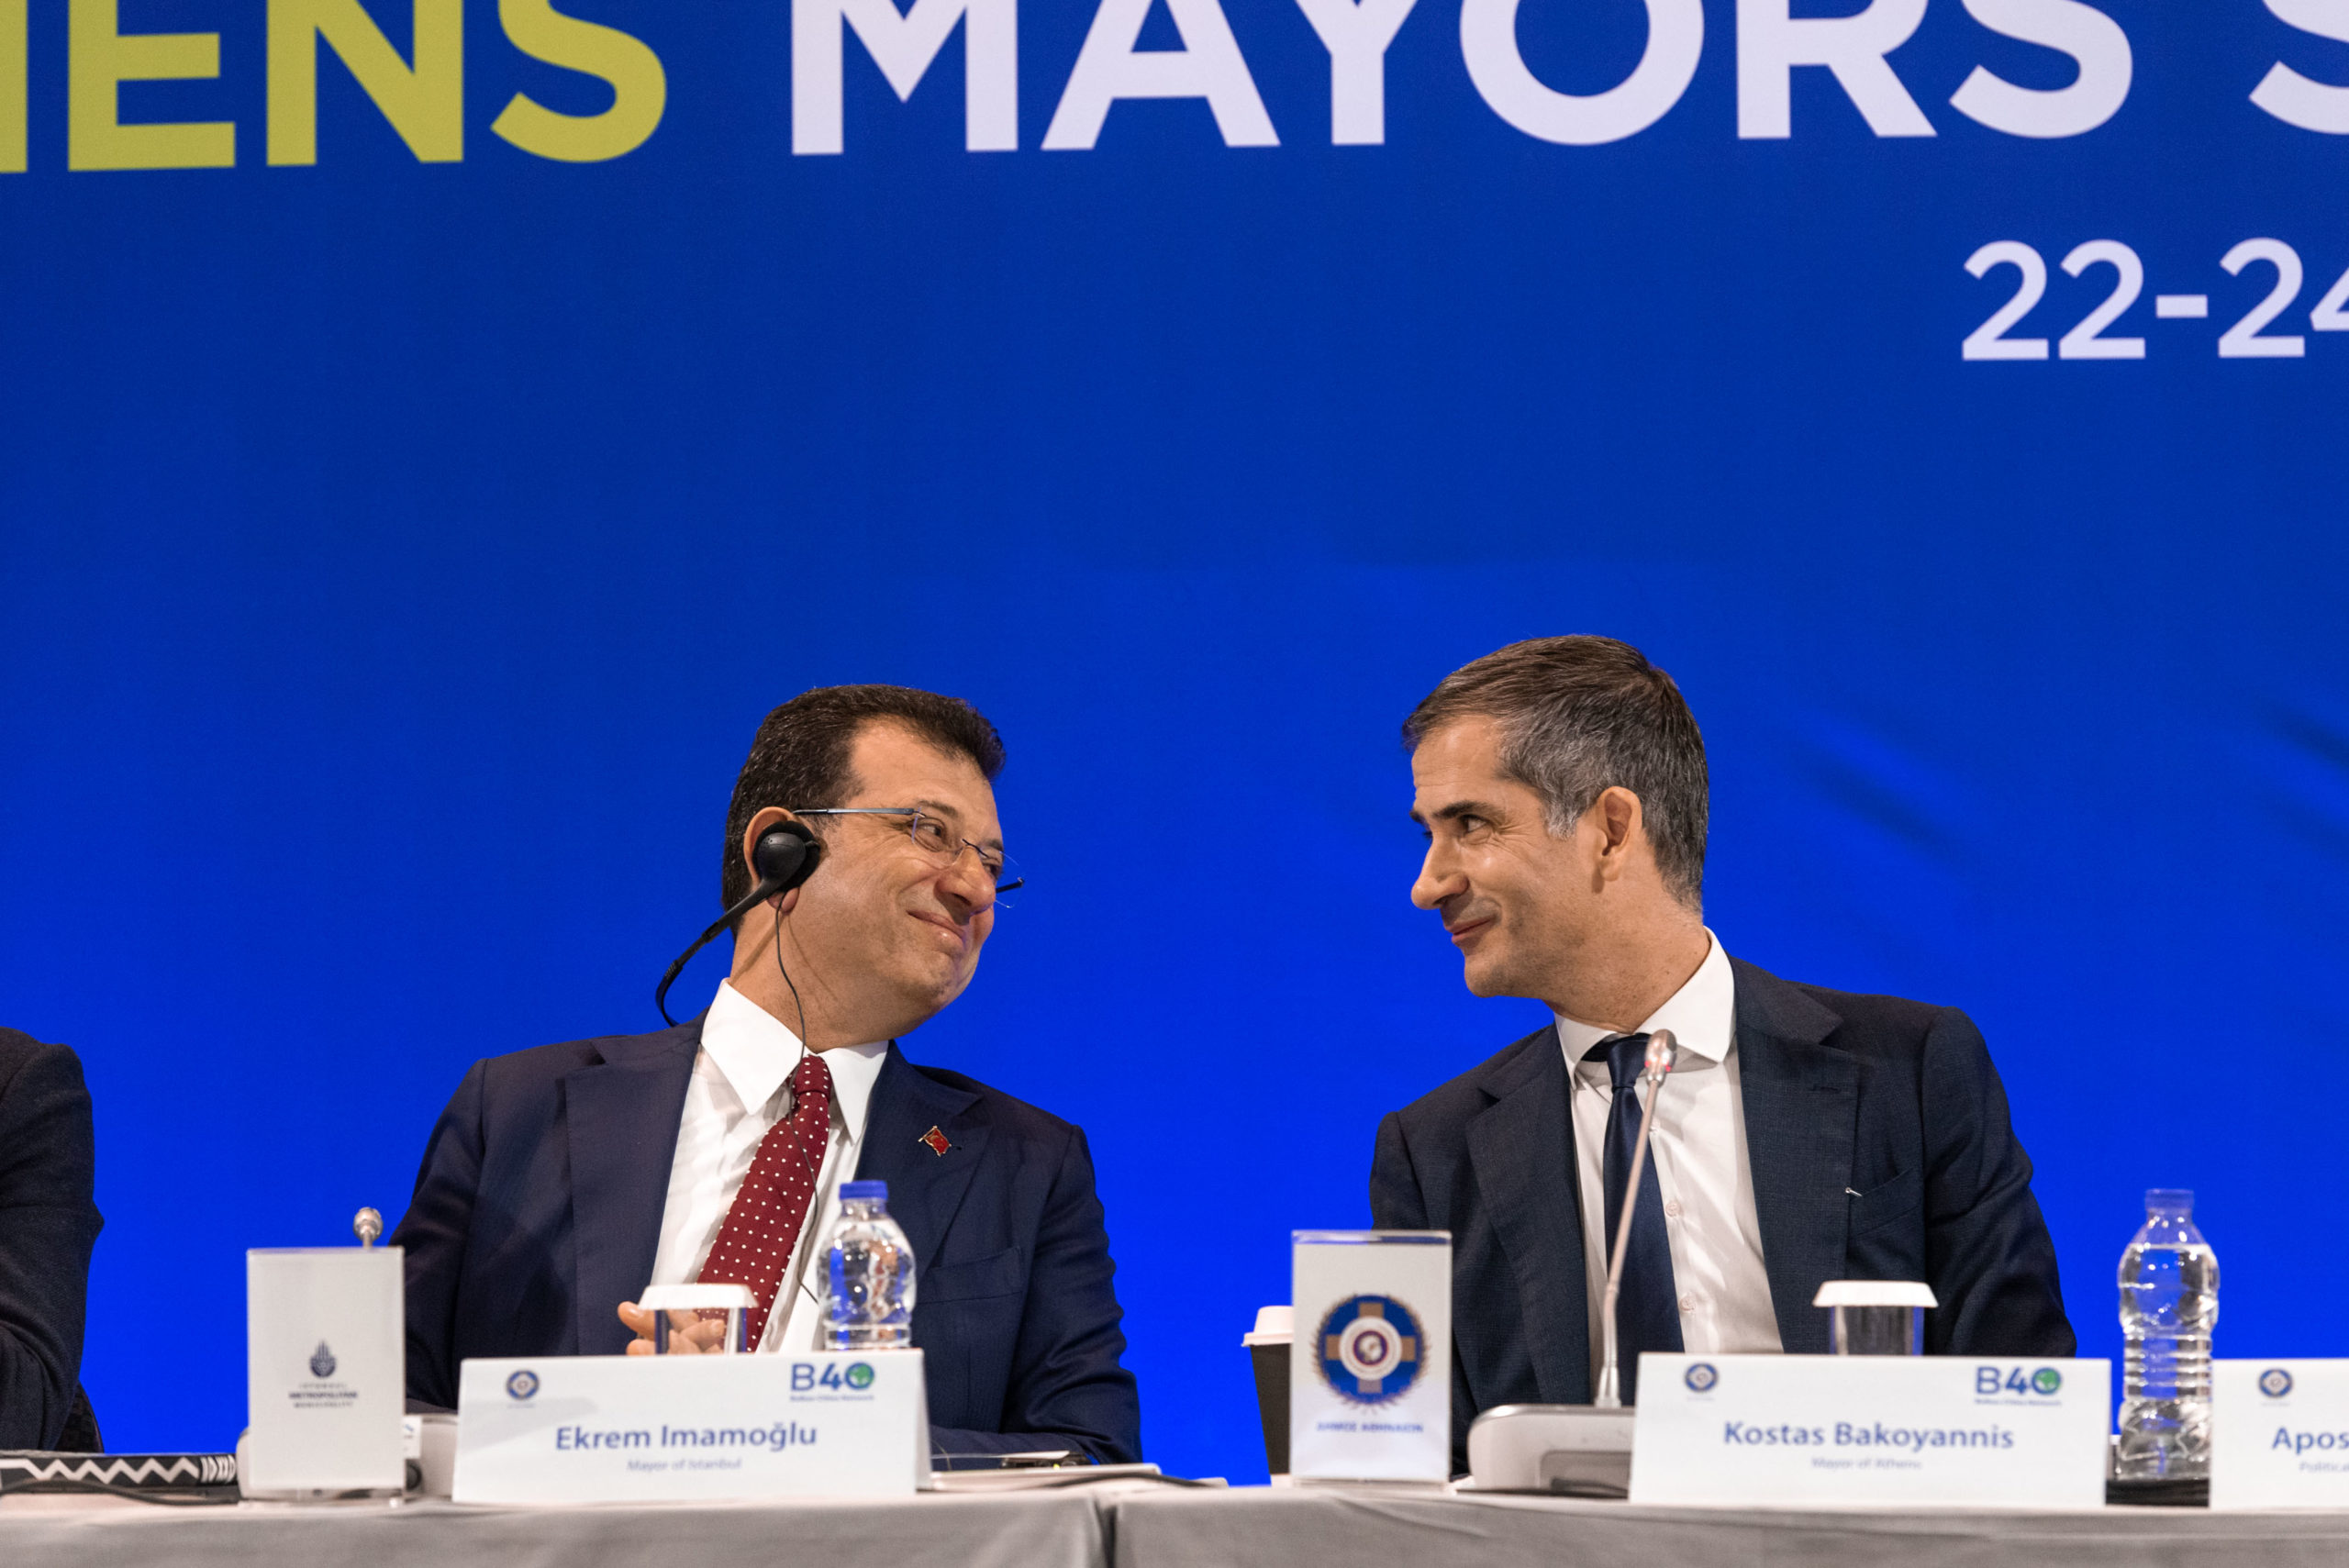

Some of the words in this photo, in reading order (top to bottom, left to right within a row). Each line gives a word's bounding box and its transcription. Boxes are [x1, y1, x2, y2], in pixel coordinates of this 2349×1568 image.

[0, 0, 667, 172] ENS
[792, 0, 2133, 155] MAYORS
[555, 1426, 651, 1451] Ekrem
[661, 1422, 818, 1452] Imamoğlu
[1723, 1421, 1825, 1446] Kostas
[1834, 1422, 2014, 1453] Bakoyannis
[2271, 1426, 2349, 1456] Apos
[671, 1458, 686, 1470] of
